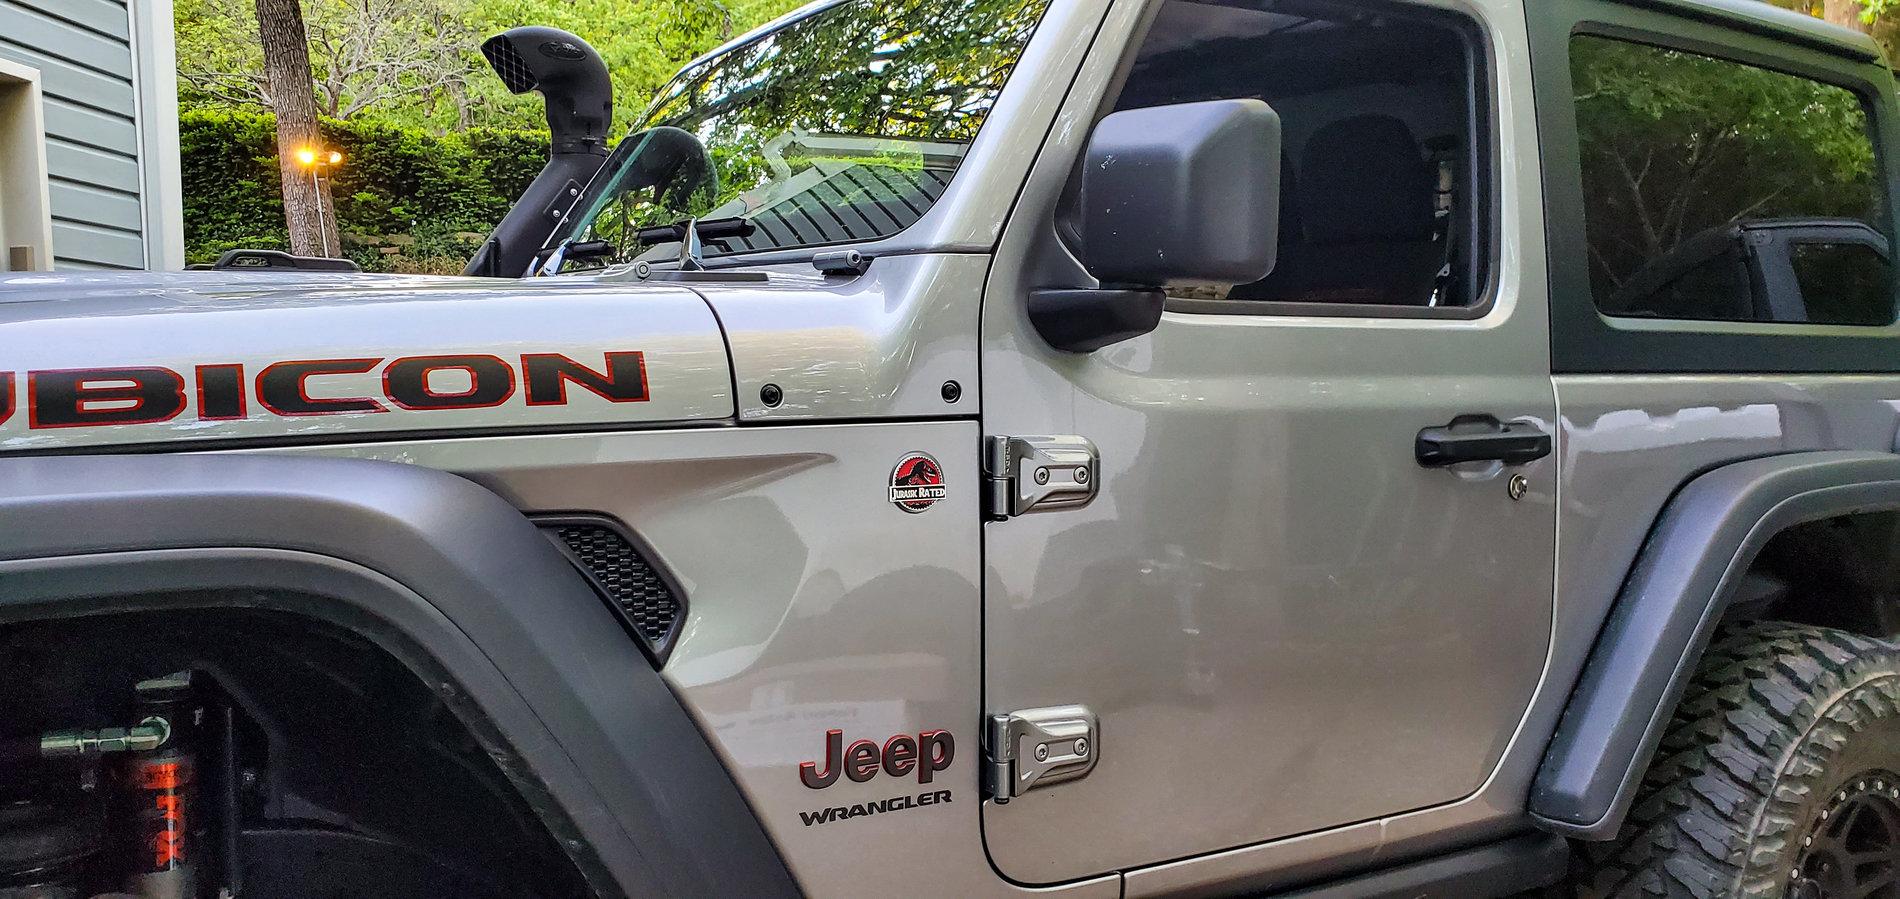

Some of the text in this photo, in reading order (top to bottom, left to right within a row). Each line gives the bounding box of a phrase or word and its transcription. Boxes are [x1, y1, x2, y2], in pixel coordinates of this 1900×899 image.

[0, 351, 650, 430] BICON
[919, 487, 945, 498] RATED
[799, 729, 955, 790] Jeep
[799, 789, 953, 827] WRANGLER
